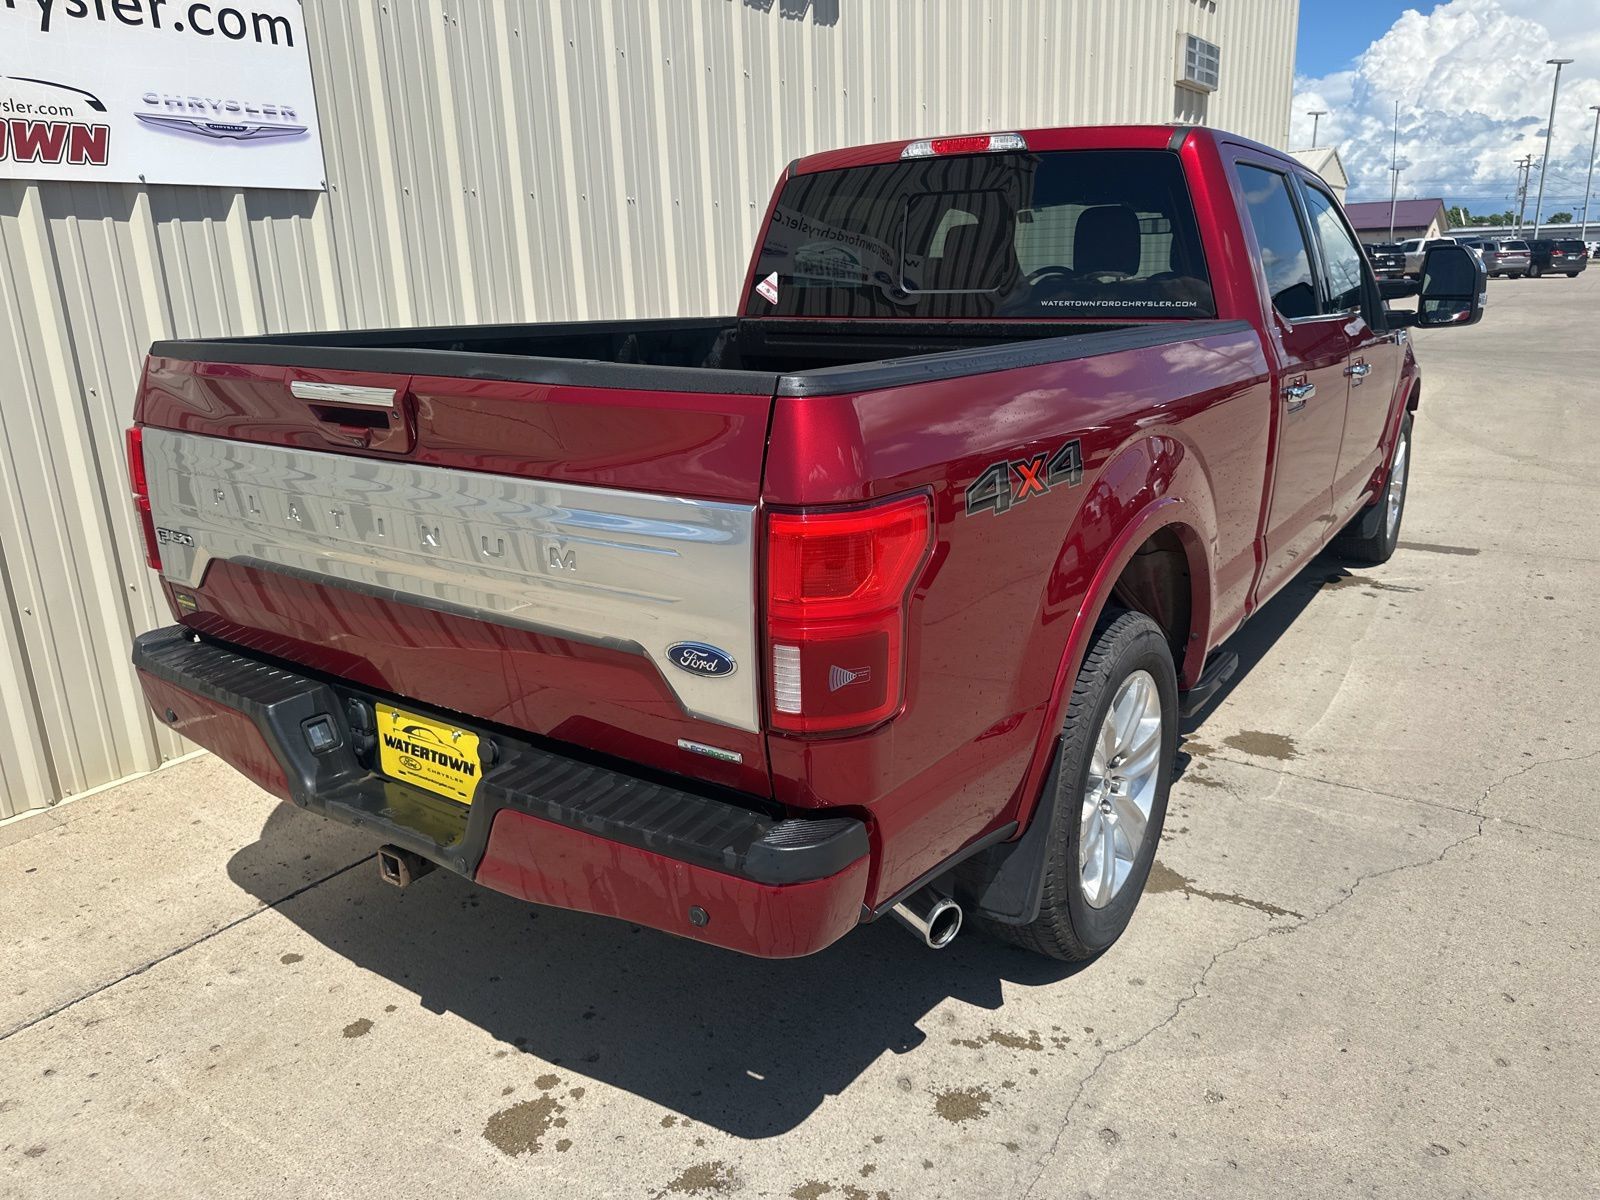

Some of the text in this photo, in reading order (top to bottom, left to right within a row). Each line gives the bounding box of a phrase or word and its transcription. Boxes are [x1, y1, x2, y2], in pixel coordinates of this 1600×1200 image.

[5, 0, 294, 47] yser.com
[0, 98, 74, 116] sler.com
[143, 92, 296, 117] CHRYSLER
[0, 117, 110, 166] WN
[1040, 300, 1198, 308] WATERTOWNFORDCHRYSLER.COM
[213, 487, 578, 572] PLATINUM
[680, 648, 719, 672] Ford
[383, 733, 476, 777] WATERTOWN
